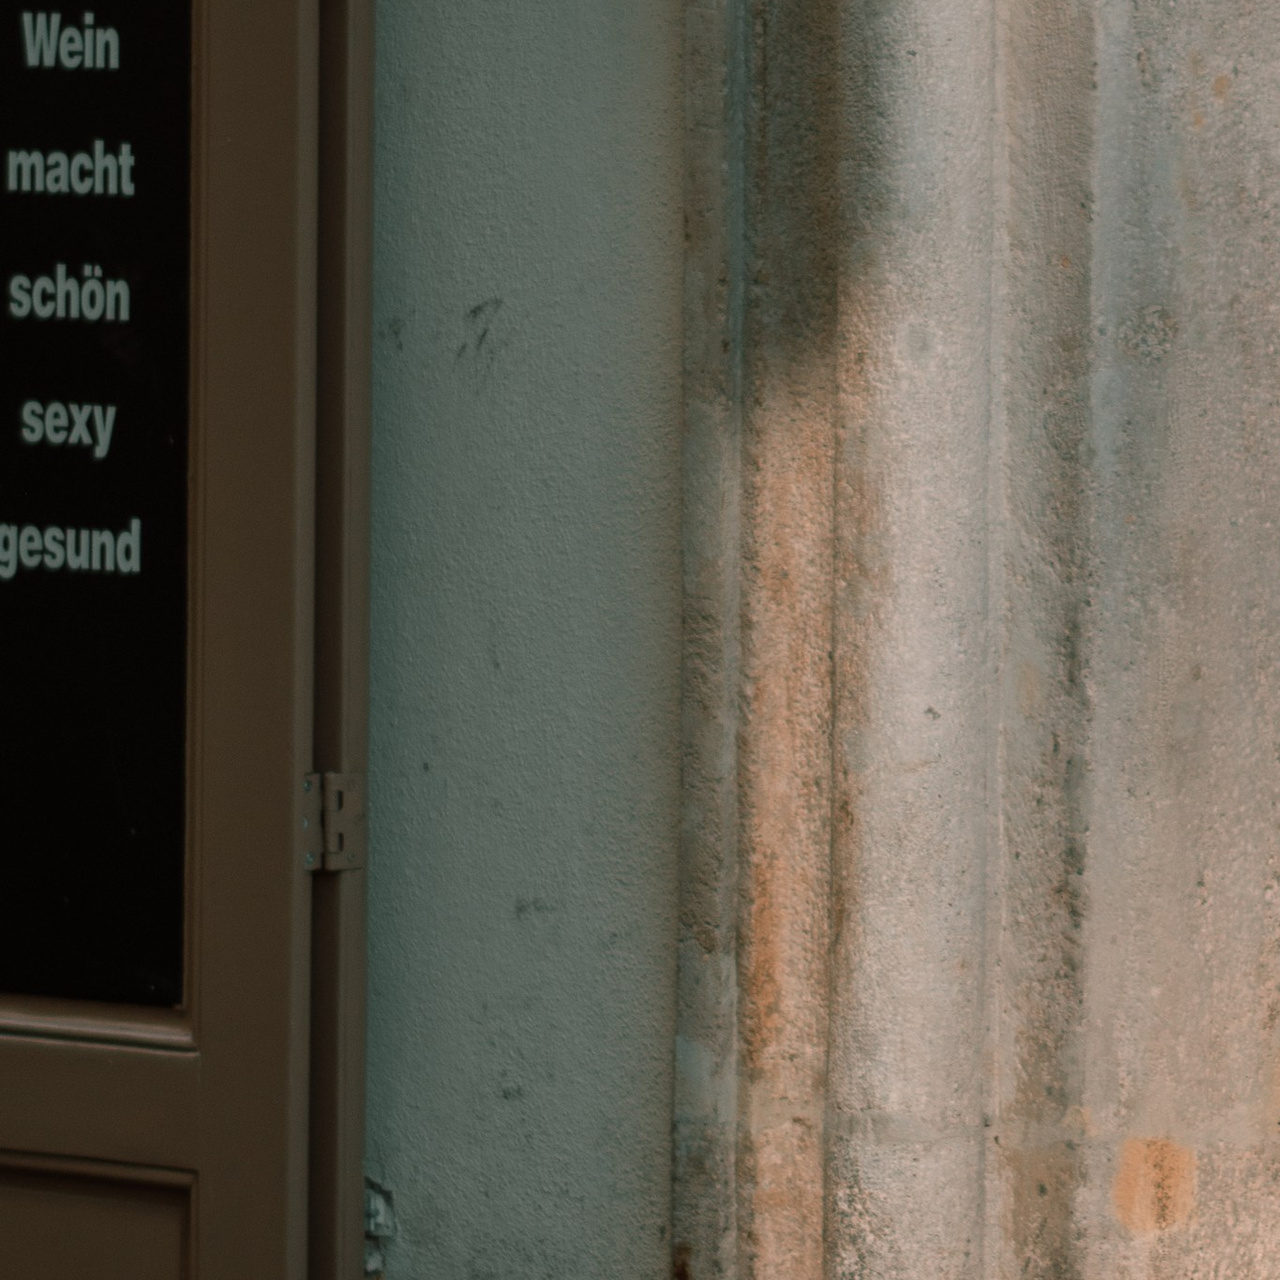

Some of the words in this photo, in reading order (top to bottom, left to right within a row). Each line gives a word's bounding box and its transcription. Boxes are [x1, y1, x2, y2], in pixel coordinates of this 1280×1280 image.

[22, 11, 120, 70] Wein
[7, 139, 135, 196] macht
[9, 263, 130, 321] schön
[21, 400, 117, 459] sexy
[0, 517, 142, 579] gesund
